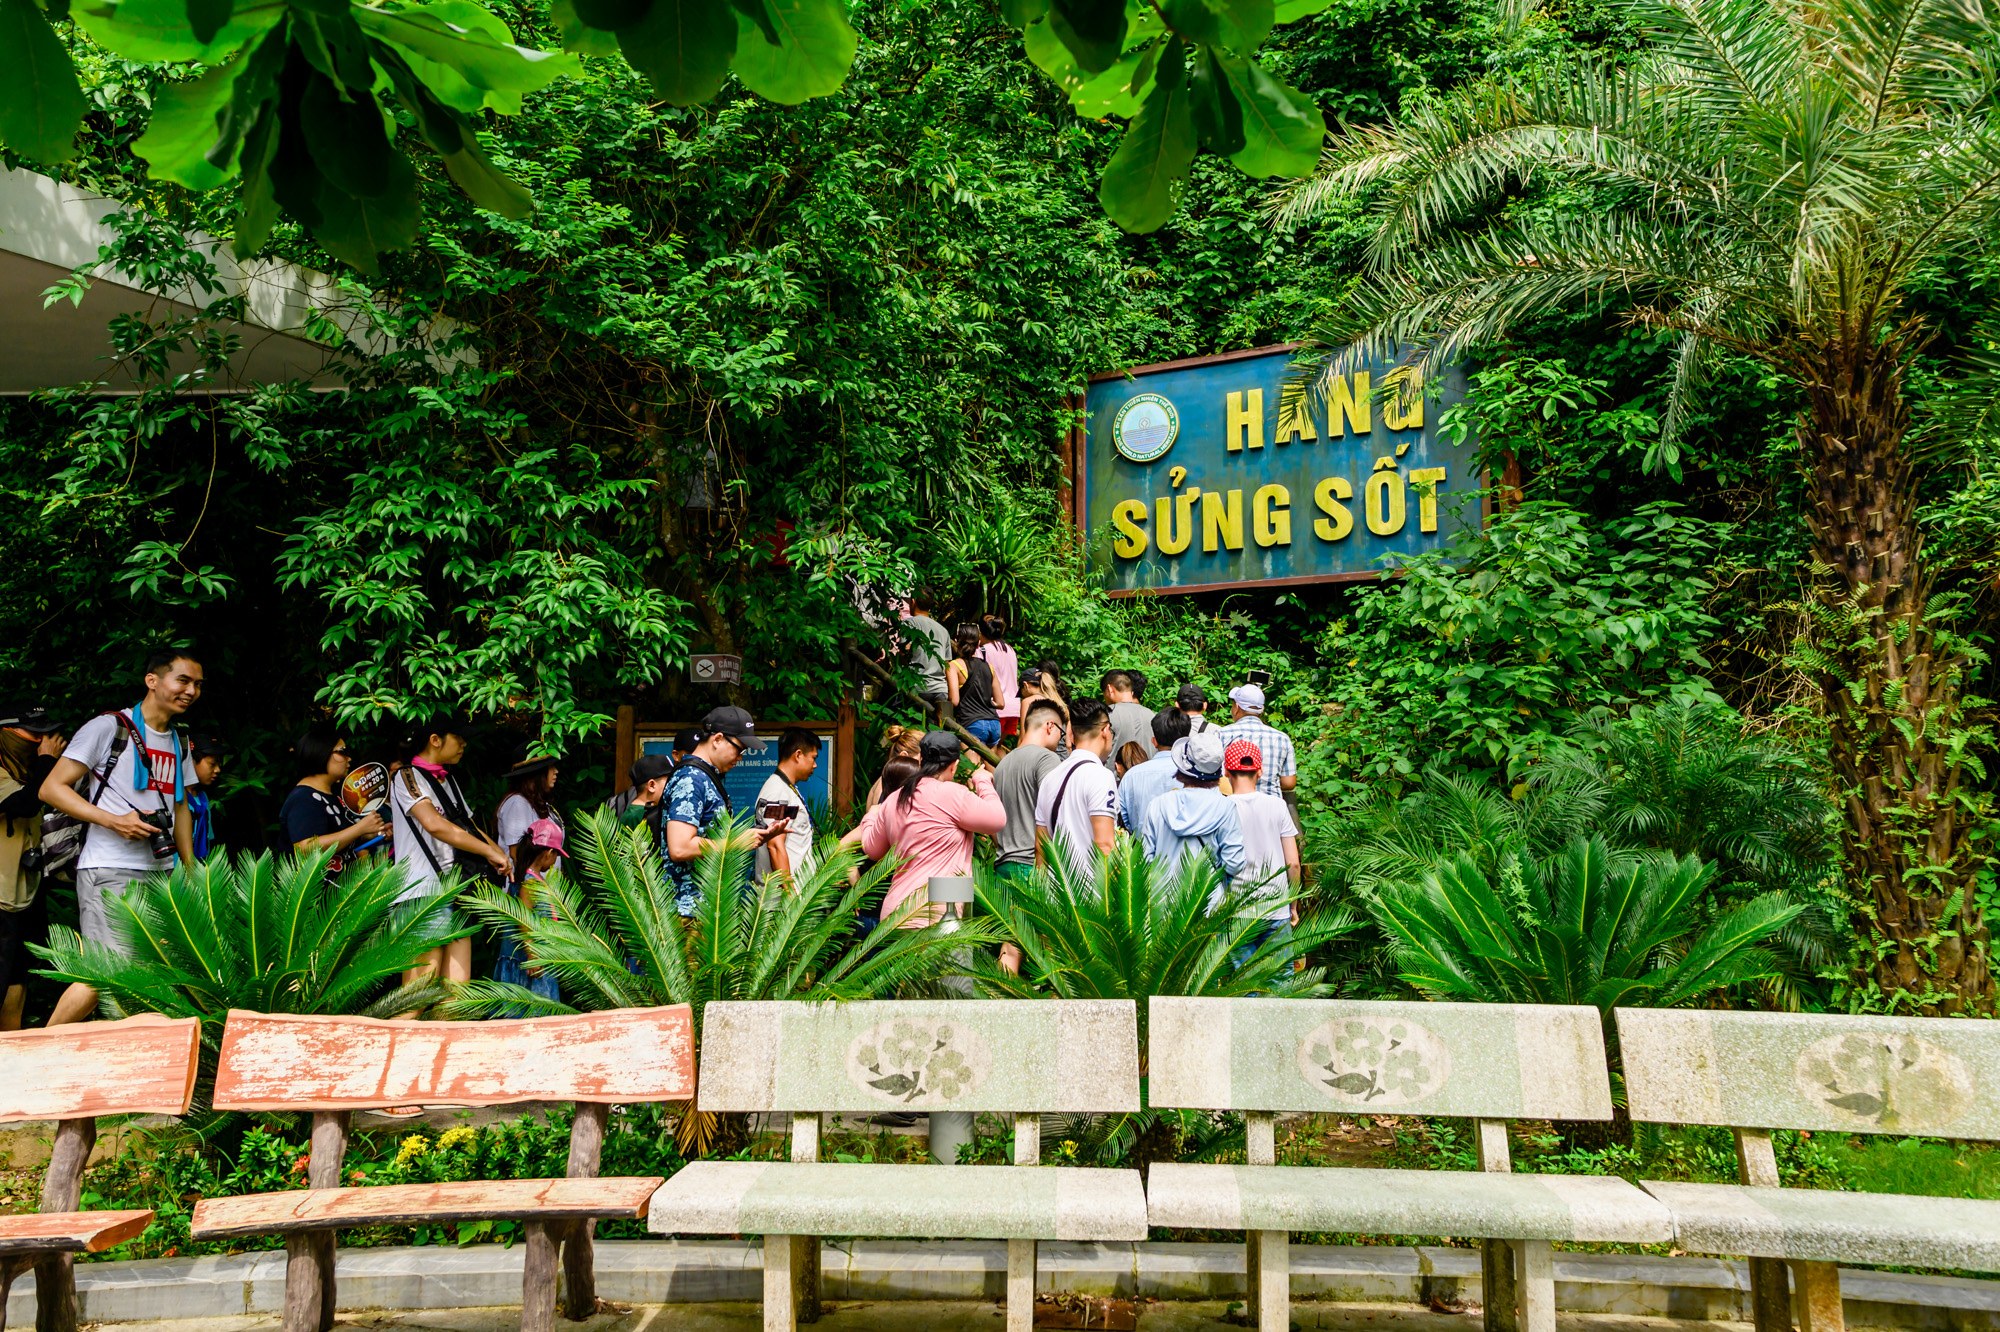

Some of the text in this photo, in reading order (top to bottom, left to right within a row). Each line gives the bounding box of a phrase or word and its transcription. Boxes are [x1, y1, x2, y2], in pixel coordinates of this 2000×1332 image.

[1226, 365, 1424, 451] HANG
[1121, 445, 1137, 458] WORLD
[1136, 449, 1162, 459] NATURAL
[1160, 425, 1176, 451] HERITAGE
[1112, 443, 1446, 559] SỬNG SỐT
[720, 670, 731, 679] NO
[1106, 790, 1115, 809] 2
